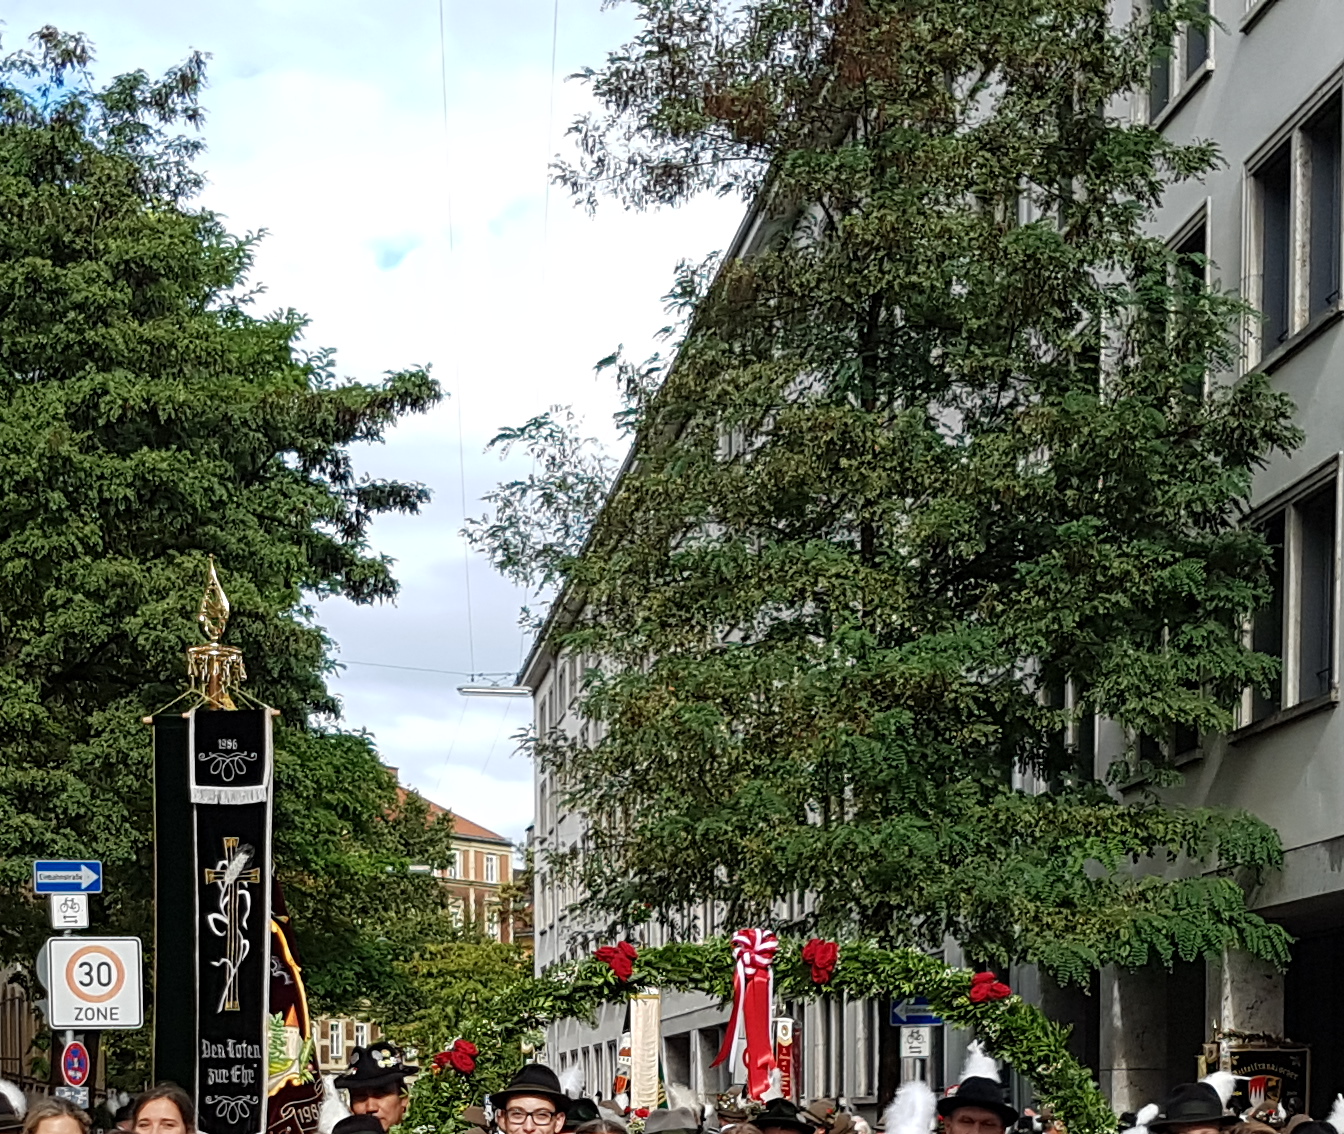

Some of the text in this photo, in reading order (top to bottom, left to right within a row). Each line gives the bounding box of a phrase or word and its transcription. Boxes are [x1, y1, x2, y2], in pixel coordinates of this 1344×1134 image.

[78, 961, 112, 988] 30
[74, 1006, 120, 1022] ZONE
[201, 1038, 262, 1059] Den Toten
[207, 1068, 229, 1085] zur
